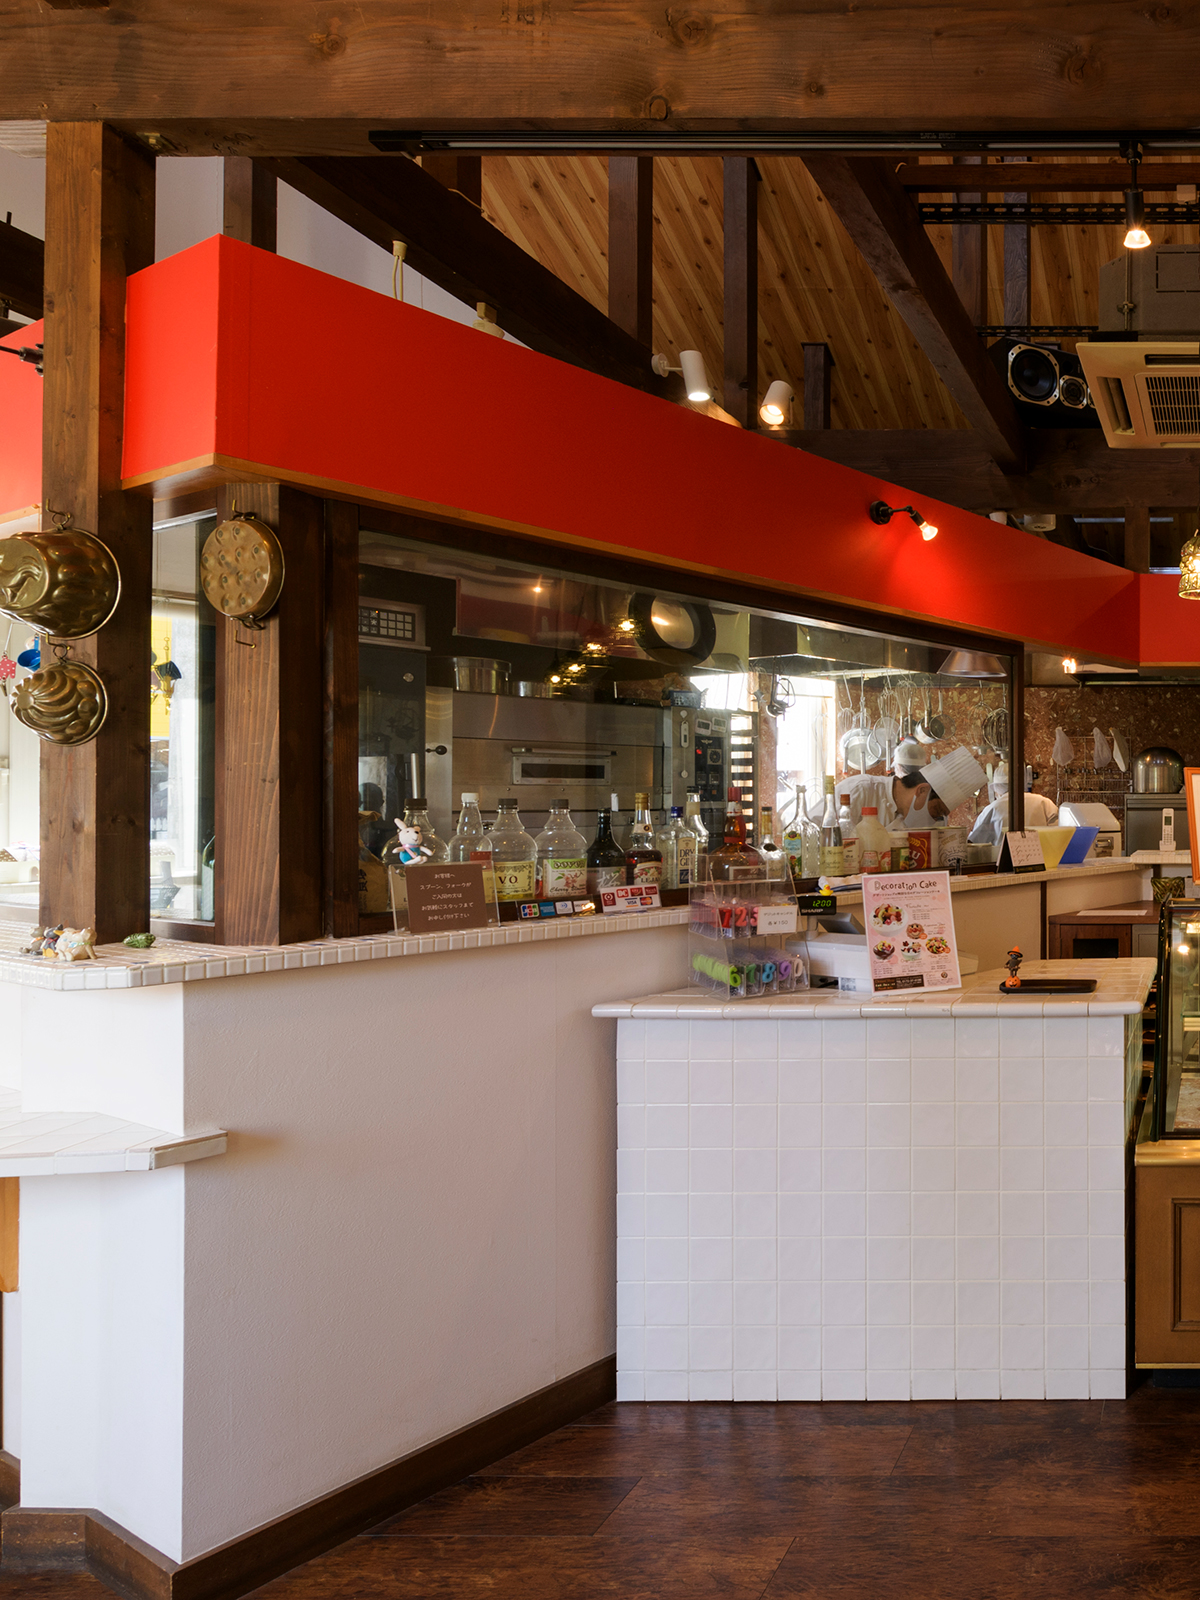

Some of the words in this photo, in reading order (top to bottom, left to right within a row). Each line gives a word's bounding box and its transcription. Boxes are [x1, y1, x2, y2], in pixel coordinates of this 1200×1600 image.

[679, 849, 695, 857] DRY
[874, 880, 917, 891] Decoration
[919, 880, 938, 889] Cake
[735, 907, 748, 927] 2
[729, 966, 741, 987] 6
[762, 963, 776, 983] 8
[779, 961, 792, 981] 9
